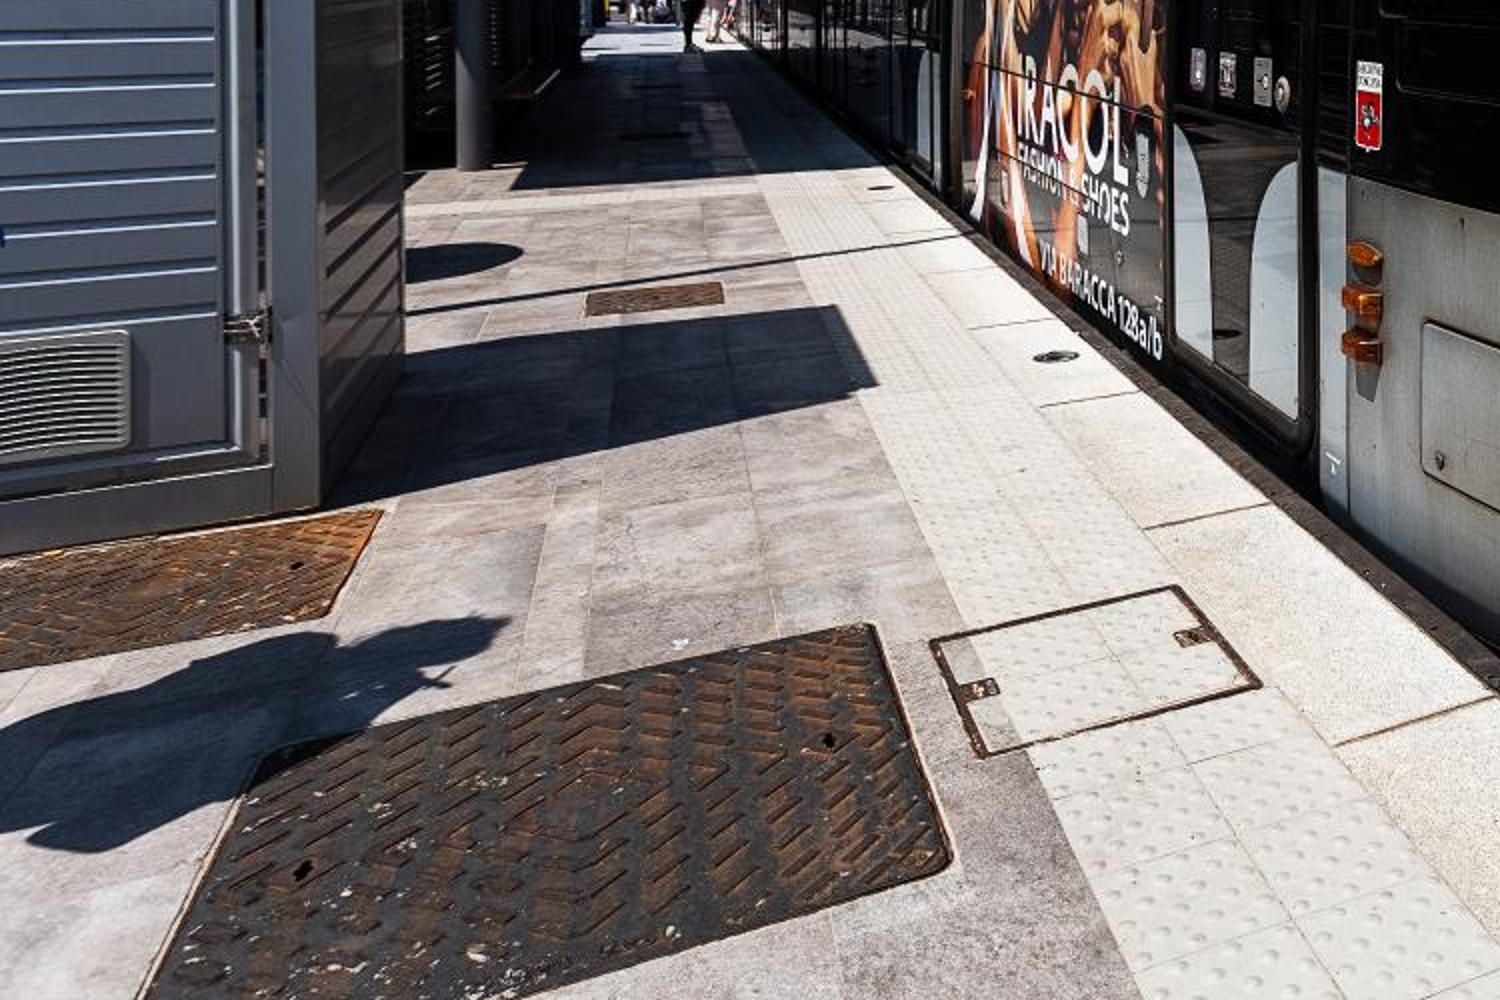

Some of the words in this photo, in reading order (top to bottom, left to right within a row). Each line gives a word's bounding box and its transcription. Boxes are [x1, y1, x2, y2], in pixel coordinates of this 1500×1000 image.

[1082, 173, 1130, 236] SHOES
[1039, 238, 1056, 277] VIA
[1059, 253, 1117, 326] BARACCA
[1118, 295, 1162, 361] 128a/b
